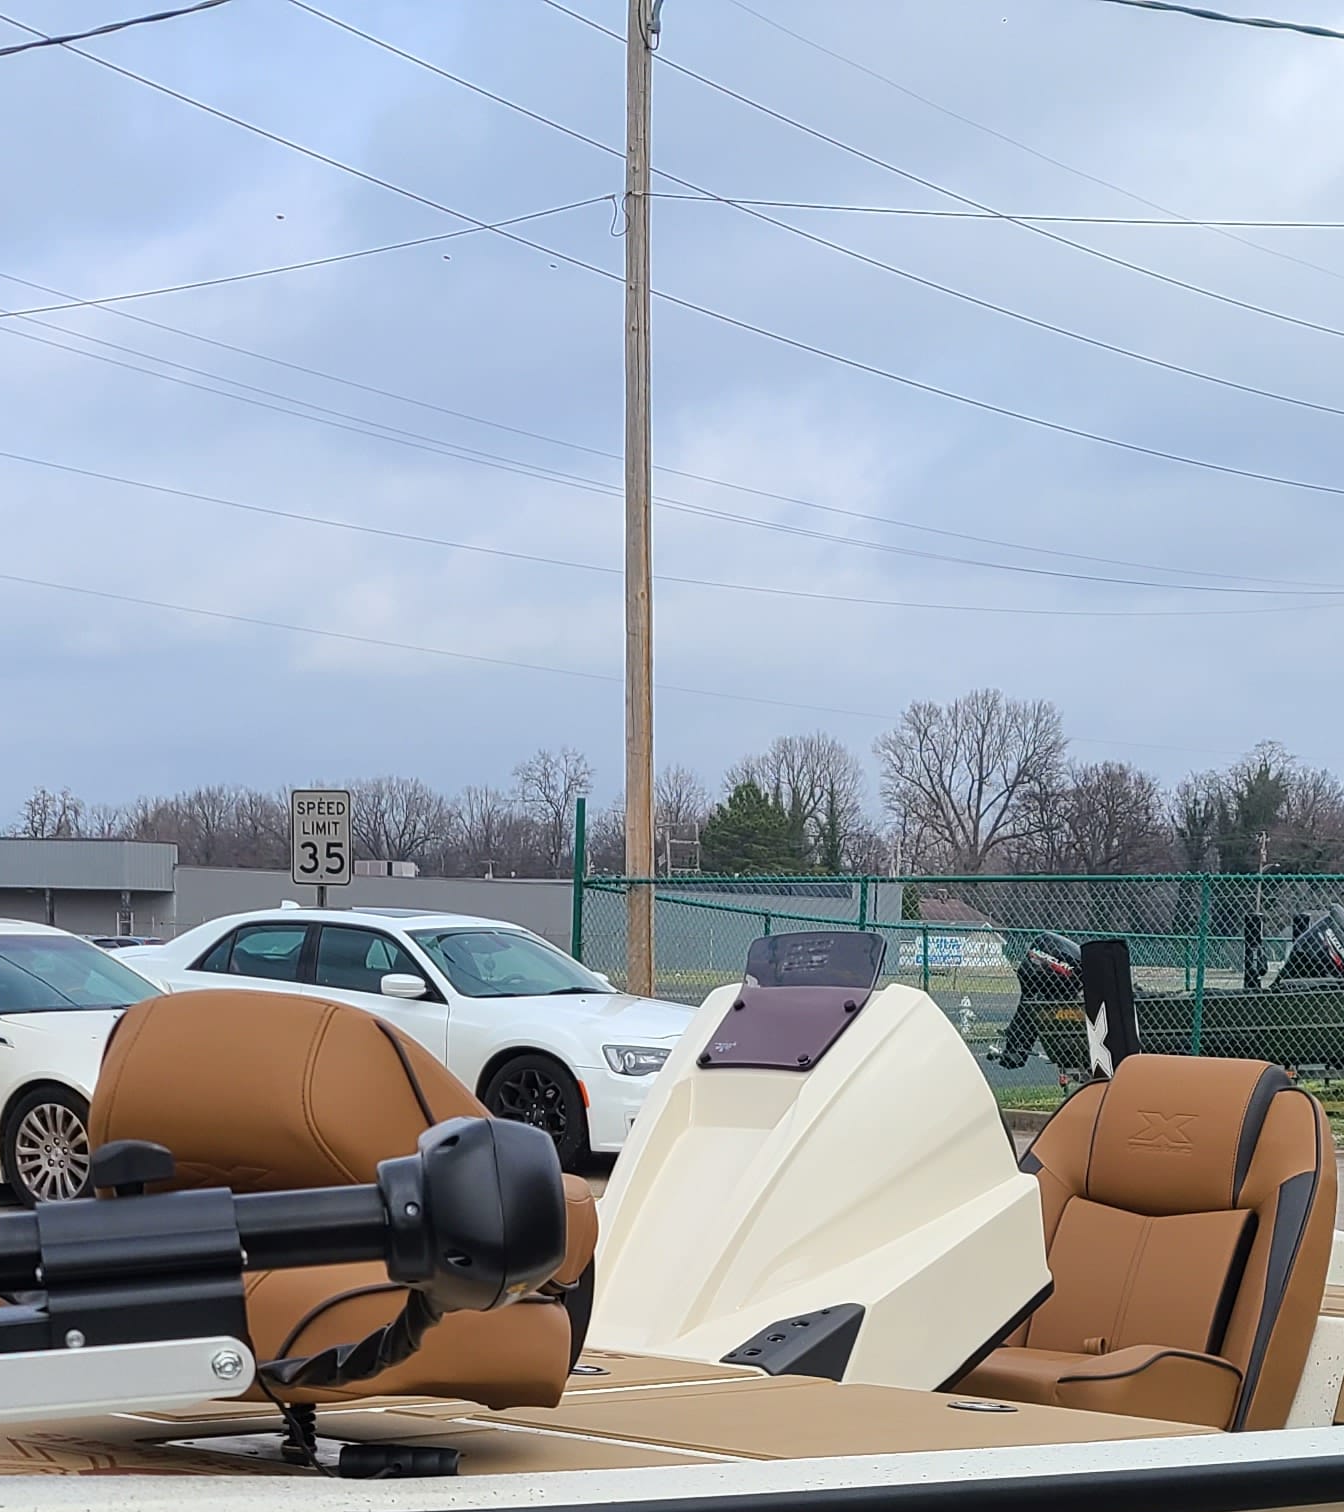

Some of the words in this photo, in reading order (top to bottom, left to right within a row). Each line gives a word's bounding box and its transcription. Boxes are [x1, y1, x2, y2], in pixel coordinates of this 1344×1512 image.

[296, 801, 346, 815] SPEED
[302, 821, 340, 836] LIMIT
[299, 841, 345, 875] 35
